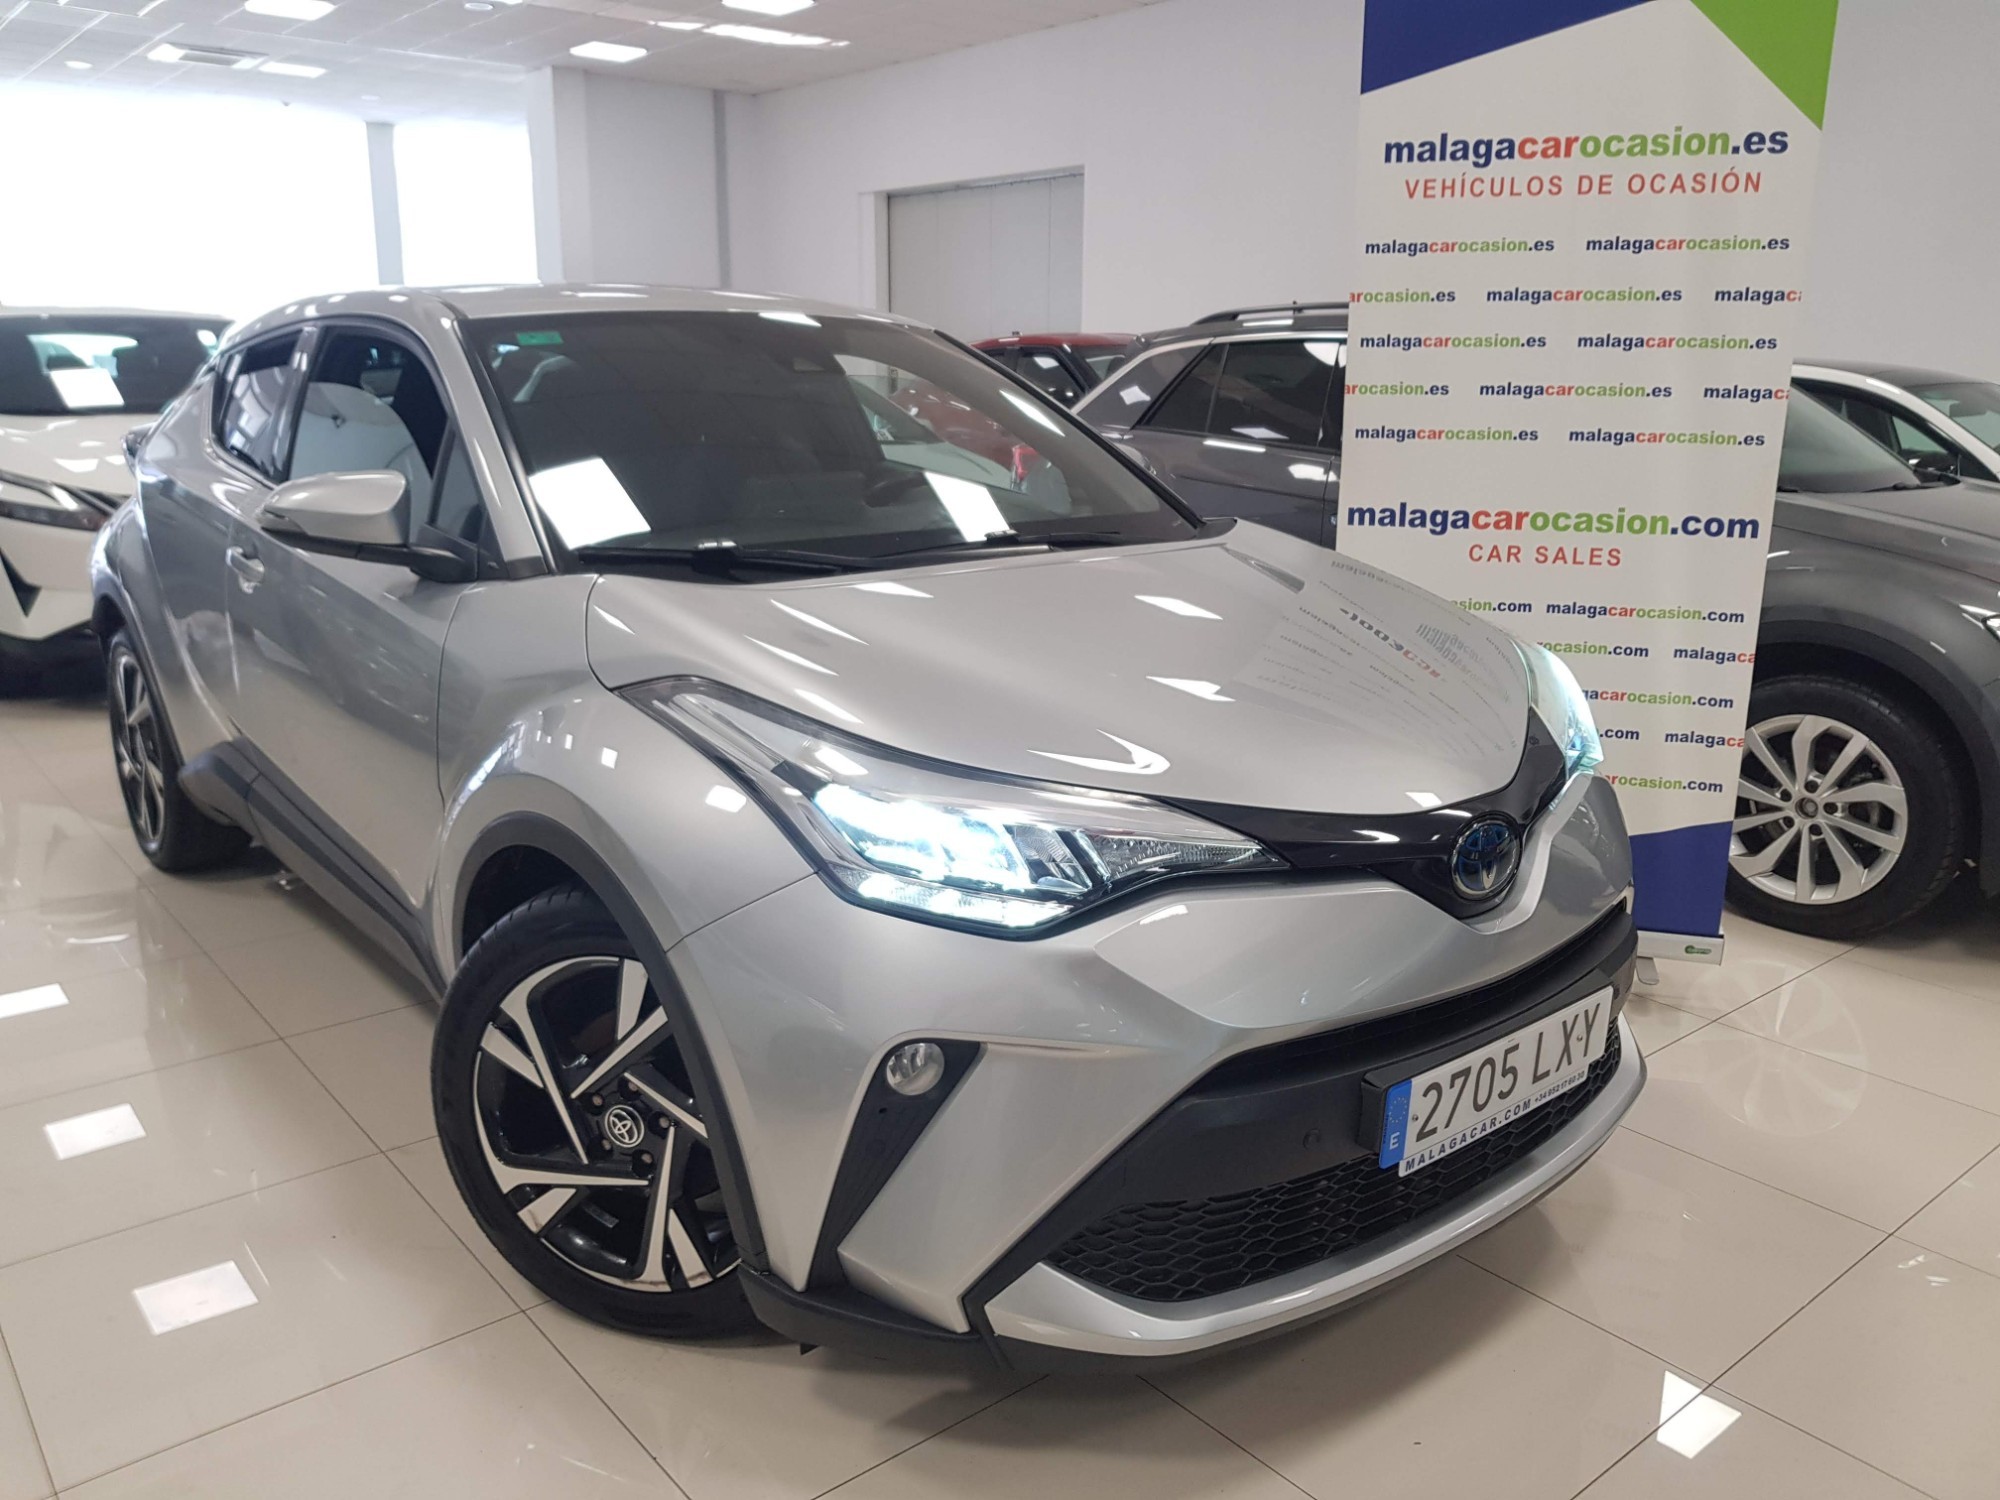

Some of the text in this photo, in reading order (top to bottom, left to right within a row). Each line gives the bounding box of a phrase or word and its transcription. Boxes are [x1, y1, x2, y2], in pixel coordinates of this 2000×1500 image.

[1384, 126, 1788, 168] malagacarocasion.es
[1405, 167, 1761, 199] VEHÍCULOS DE OCASIÓN
[1365, 238, 1554, 257] malagacarocasion.es
[1586, 235, 1789, 254] malagacarocasion.es
[1487, 287, 1682, 305] malagacarocasion.es
[1360, 334, 1546, 351] malagacarocasion.es
[1578, 333, 1777, 352] malagacarocasion.es
[1480, 382, 1672, 399] malagacarocasion.es
[1355, 425, 1538, 443] malagacarocasion.es
[1569, 428, 1765, 446] malagacarocasion.es
[1348, 502, 1759, 539] malagacarocasion.com
[1469, 544, 1620, 566] CAR SALES
[1546, 602, 1744, 623] malagacarocasion.com
[1416, 1003, 1601, 1143] 2705 LXY
[1389, 1131, 1400, 1150] E
[1405, 1099, 1531, 1172] MALAGACAR.COM
